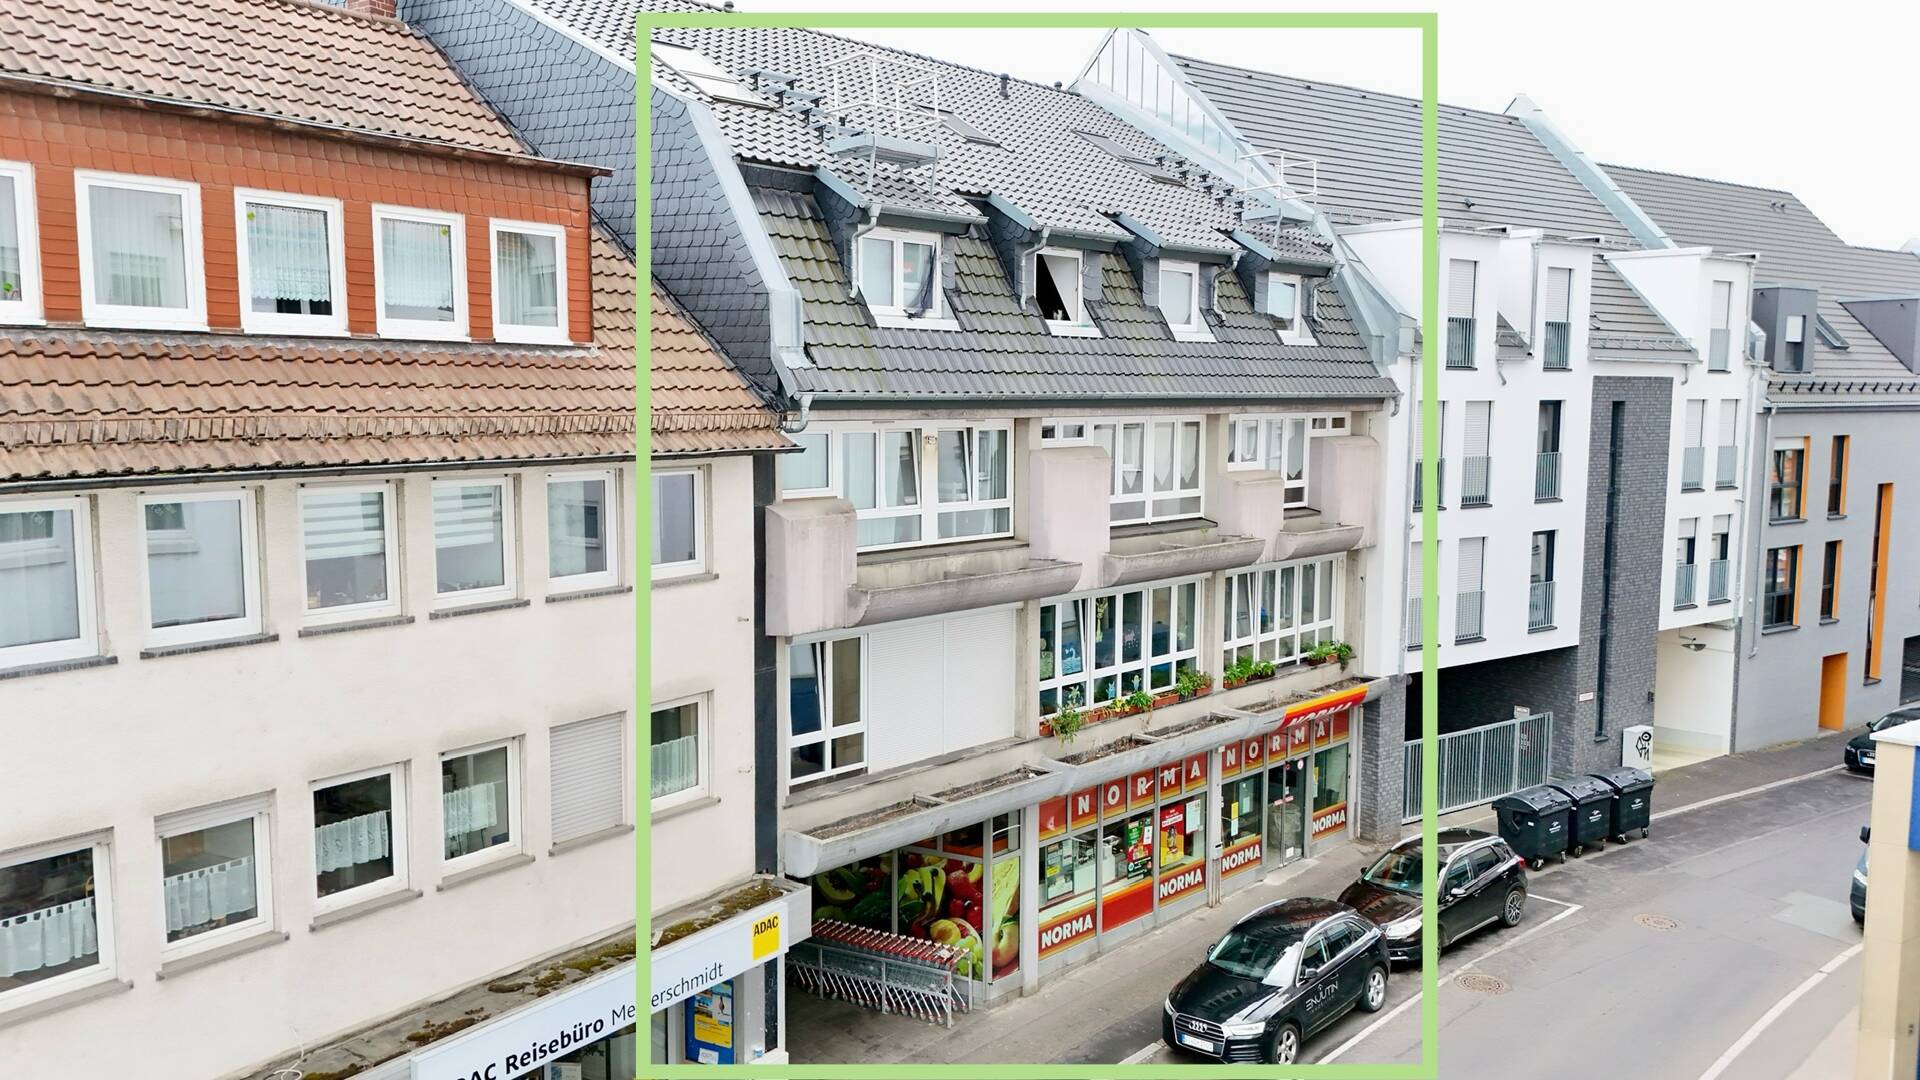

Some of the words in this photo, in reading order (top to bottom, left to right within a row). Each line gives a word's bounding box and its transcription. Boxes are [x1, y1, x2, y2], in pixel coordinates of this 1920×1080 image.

[1312, 809, 1346, 834] NORMA
[1222, 844, 1261, 872] NORMA
[1159, 868, 1203, 898] NORMA
[753, 915, 779, 937] ADAC
[1041, 914, 1093, 949] NORMA
[505, 1018, 604, 1075] Reisebüro
[611, 962, 724, 1026] Meerschmidt
